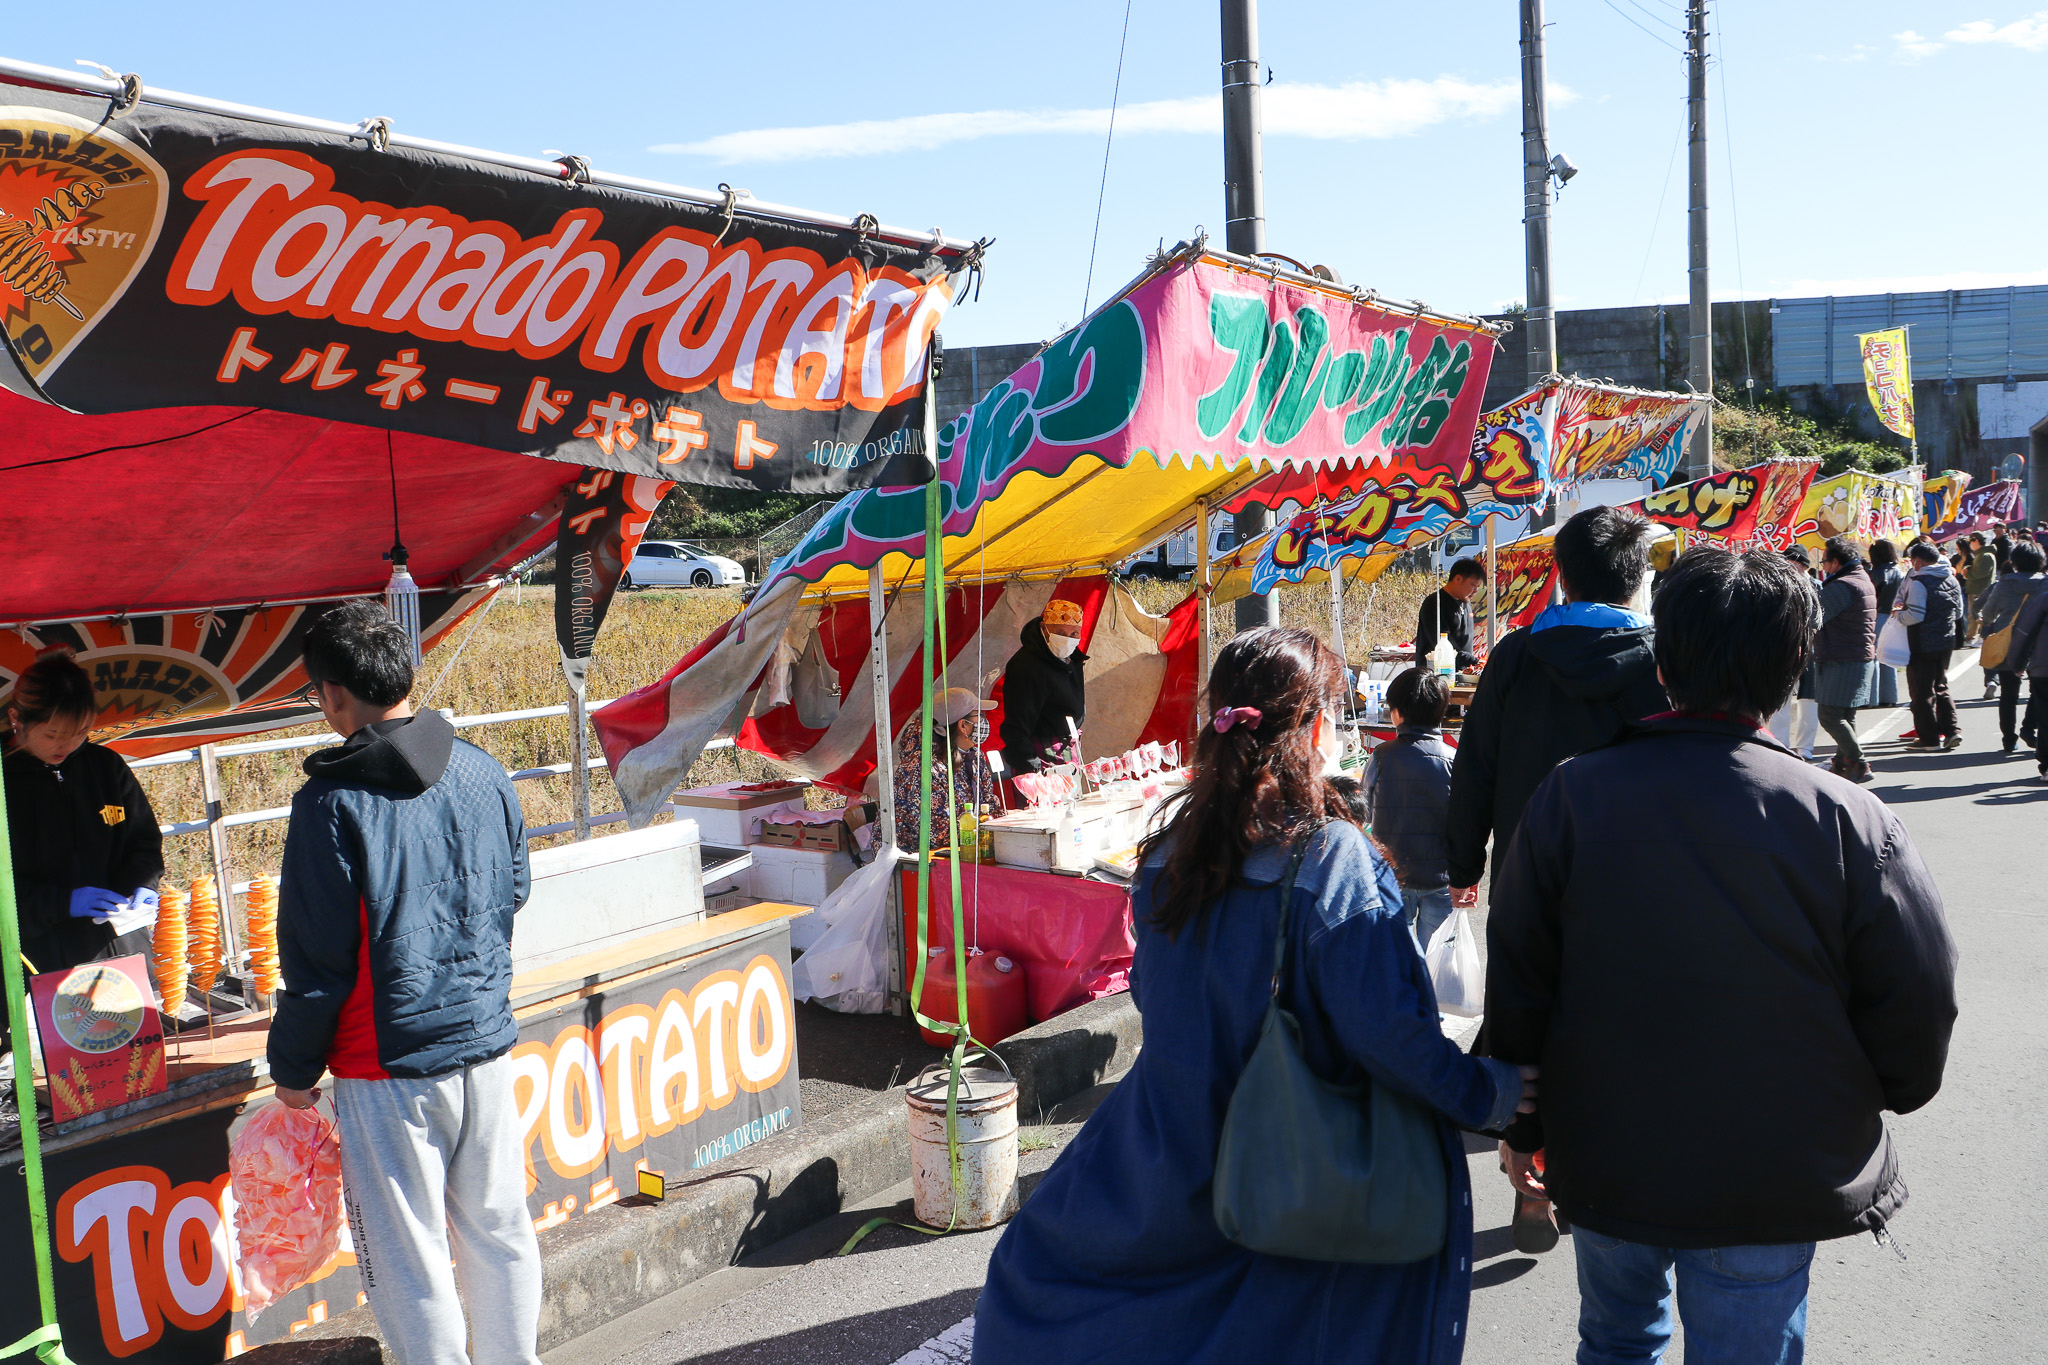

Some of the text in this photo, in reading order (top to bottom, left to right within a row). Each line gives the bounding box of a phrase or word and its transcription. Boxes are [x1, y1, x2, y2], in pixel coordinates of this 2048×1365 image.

[51, 226, 137, 250] TASTY!
[184, 155, 606, 348] Tornado
[811, 439, 859, 469] 100%
[571, 550, 595, 658] 100% ORGANIC
[57, 1012, 75, 1022] FAST
[694, 1106, 791, 1168] 100% ORGANIC
[355, 1201, 366, 1241] BRASIL
[362, 1243, 369, 1256] do
[365, 1257, 377, 1288] FINTA
